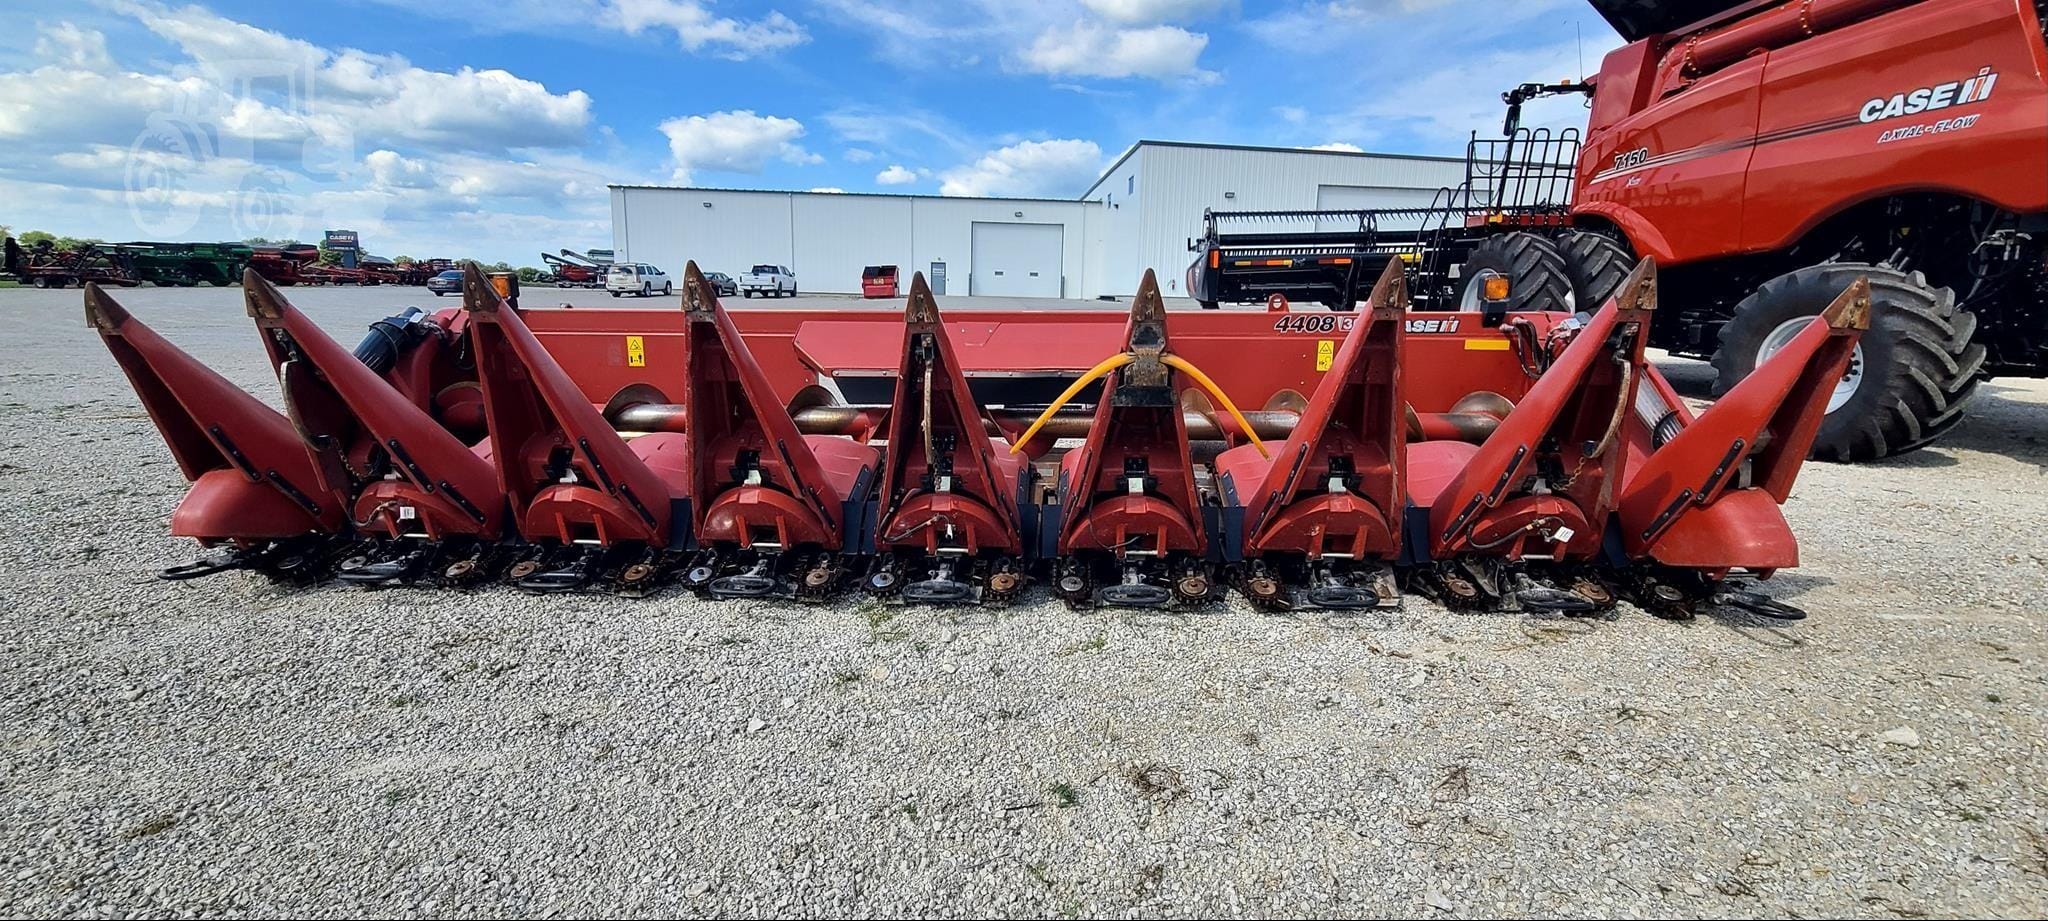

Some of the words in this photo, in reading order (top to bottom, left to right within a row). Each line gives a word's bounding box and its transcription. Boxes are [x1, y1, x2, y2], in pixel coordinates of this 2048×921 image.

[1858, 82, 1959, 124] CASE
[1877, 114, 1981, 144] AXIAL-FLOW
[1614, 147, 1648, 171] 7150
[1274, 314, 1336, 333] 4408
